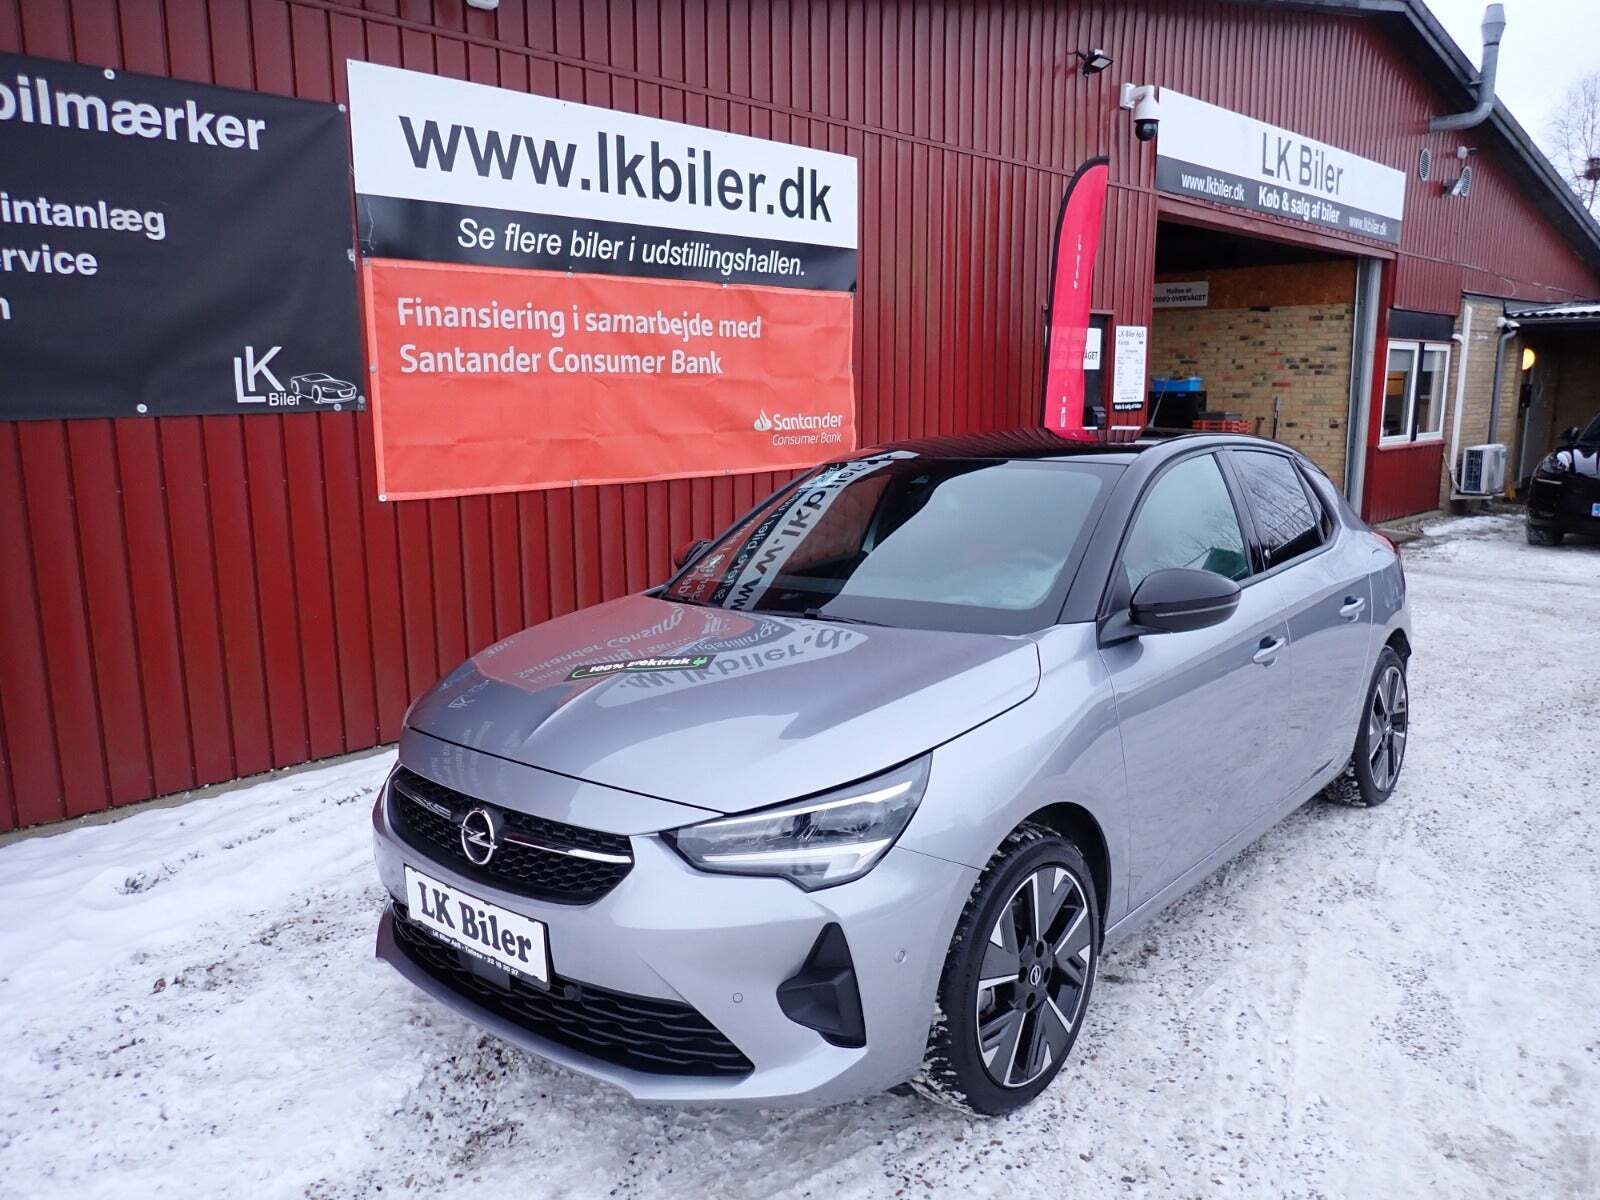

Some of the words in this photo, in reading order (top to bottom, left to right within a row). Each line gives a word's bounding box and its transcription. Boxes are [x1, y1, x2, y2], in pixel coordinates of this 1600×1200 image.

[398, 115, 833, 223] www.lkbiler.dk
[1261, 132, 1292, 181] LK
[1299, 145, 1344, 195] Biler
[1181, 174, 1245, 201] www.lkbiler.dk
[1259, 186, 1280, 209] Køb
[1282, 191, 1290, 211] &
[1291, 197, 1310, 222] salg
[1311, 202, 1321, 219] af
[1321, 203, 1340, 224] biler
[0, 244, 98, 275] rvice
[457, 218, 495, 250] Se
[505, 223, 562, 255] flere
[570, 230, 624, 260] biler
[629, 236, 636, 262] i
[642, 239, 805, 276] udstillingshallen.
[398, 297, 566, 338] Finansiering
[572, 304, 579, 331] i
[585, 310, 713, 342] samarbejde
[719, 316, 761, 338] med
[234, 346, 286, 403] LK
[400, 344, 541, 373] Santander
[548, 347, 665, 374] Consumer
[671, 350, 723, 374] Bank
[269, 392, 301, 406] Biler
[772, 434, 818, 446] Consumer
[820, 432, 842, 444] Bank
[773, 412, 843, 431] Santander
[417, 881, 455, 929] LK
[459, 901, 532, 962] Biler
